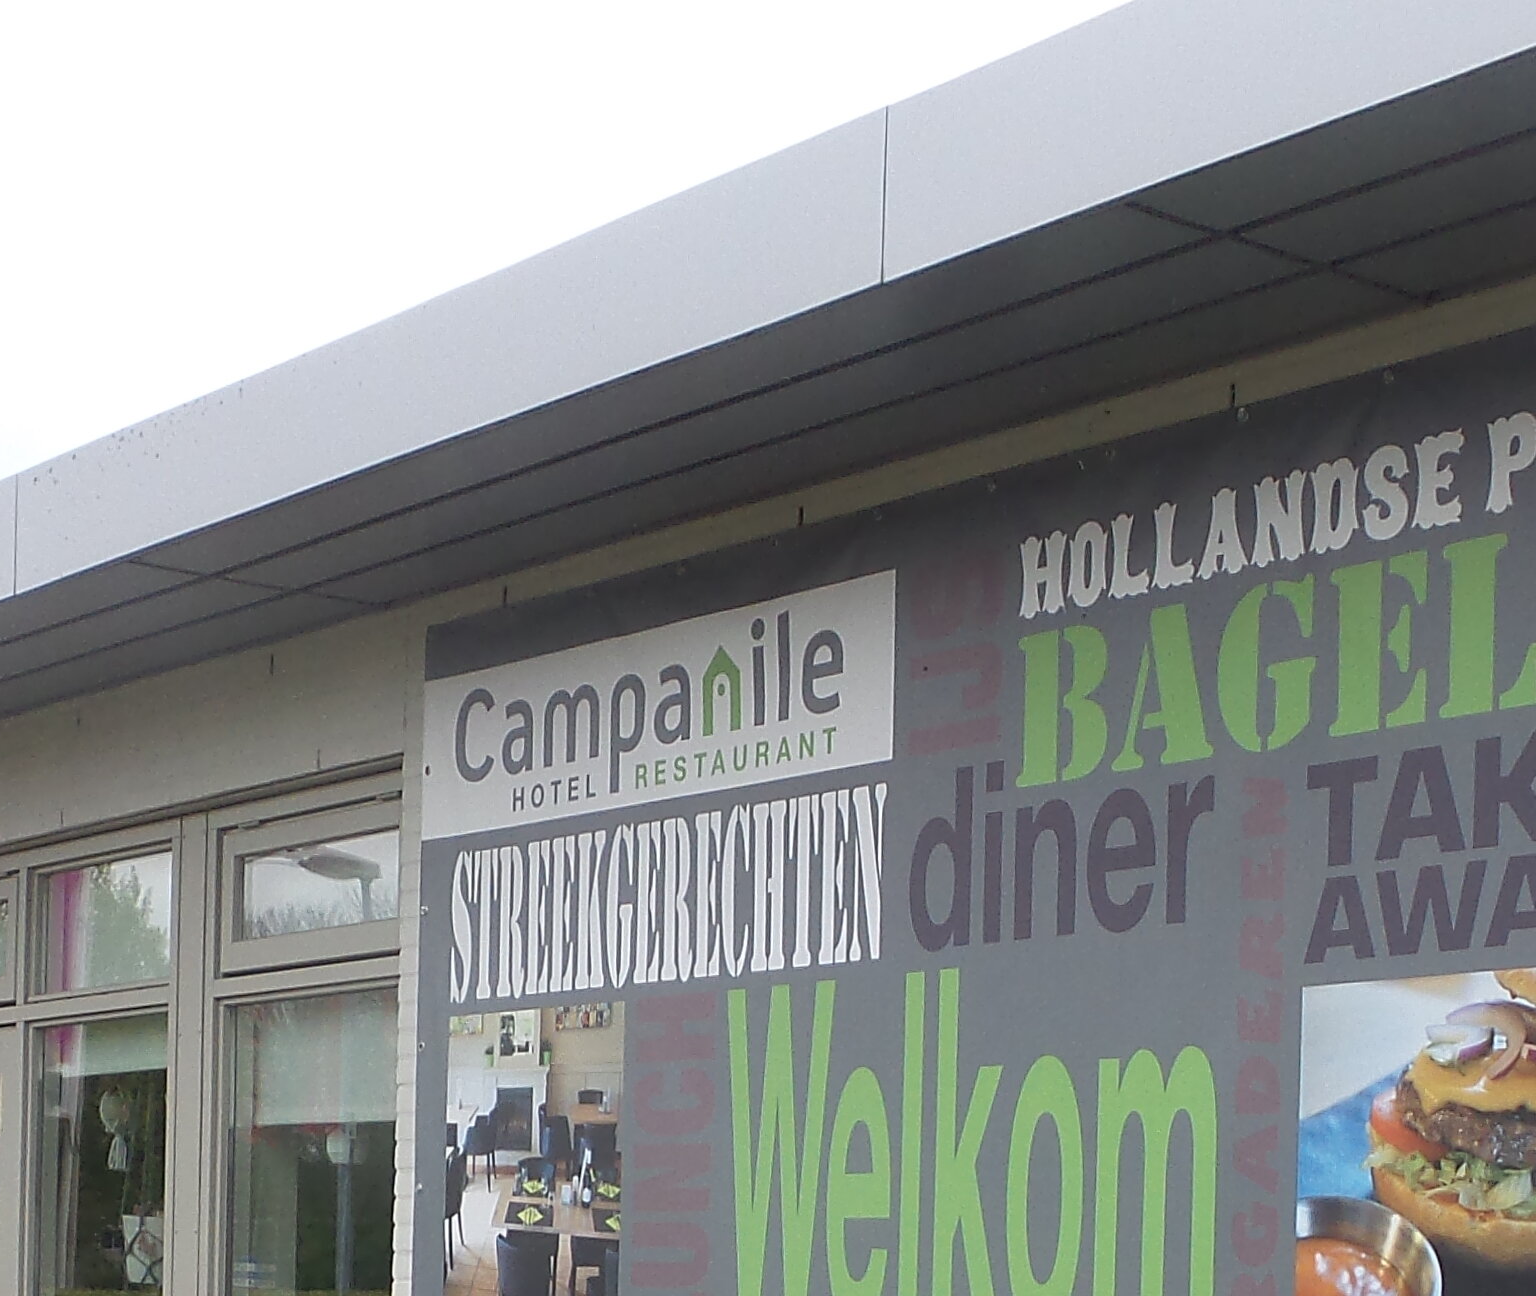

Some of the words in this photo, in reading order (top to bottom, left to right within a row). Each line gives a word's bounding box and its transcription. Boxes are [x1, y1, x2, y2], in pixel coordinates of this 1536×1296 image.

[1018, 429, 1464, 620] HOLLANDSE
[454, 610, 845, 793] Campanile
[512, 774, 596, 812] HOTEL
[635, 727, 839, 789] RESTAURANT
[450, 783, 887, 1003] STREEKGERECHTEN
[909, 760, 1215, 954] diner
